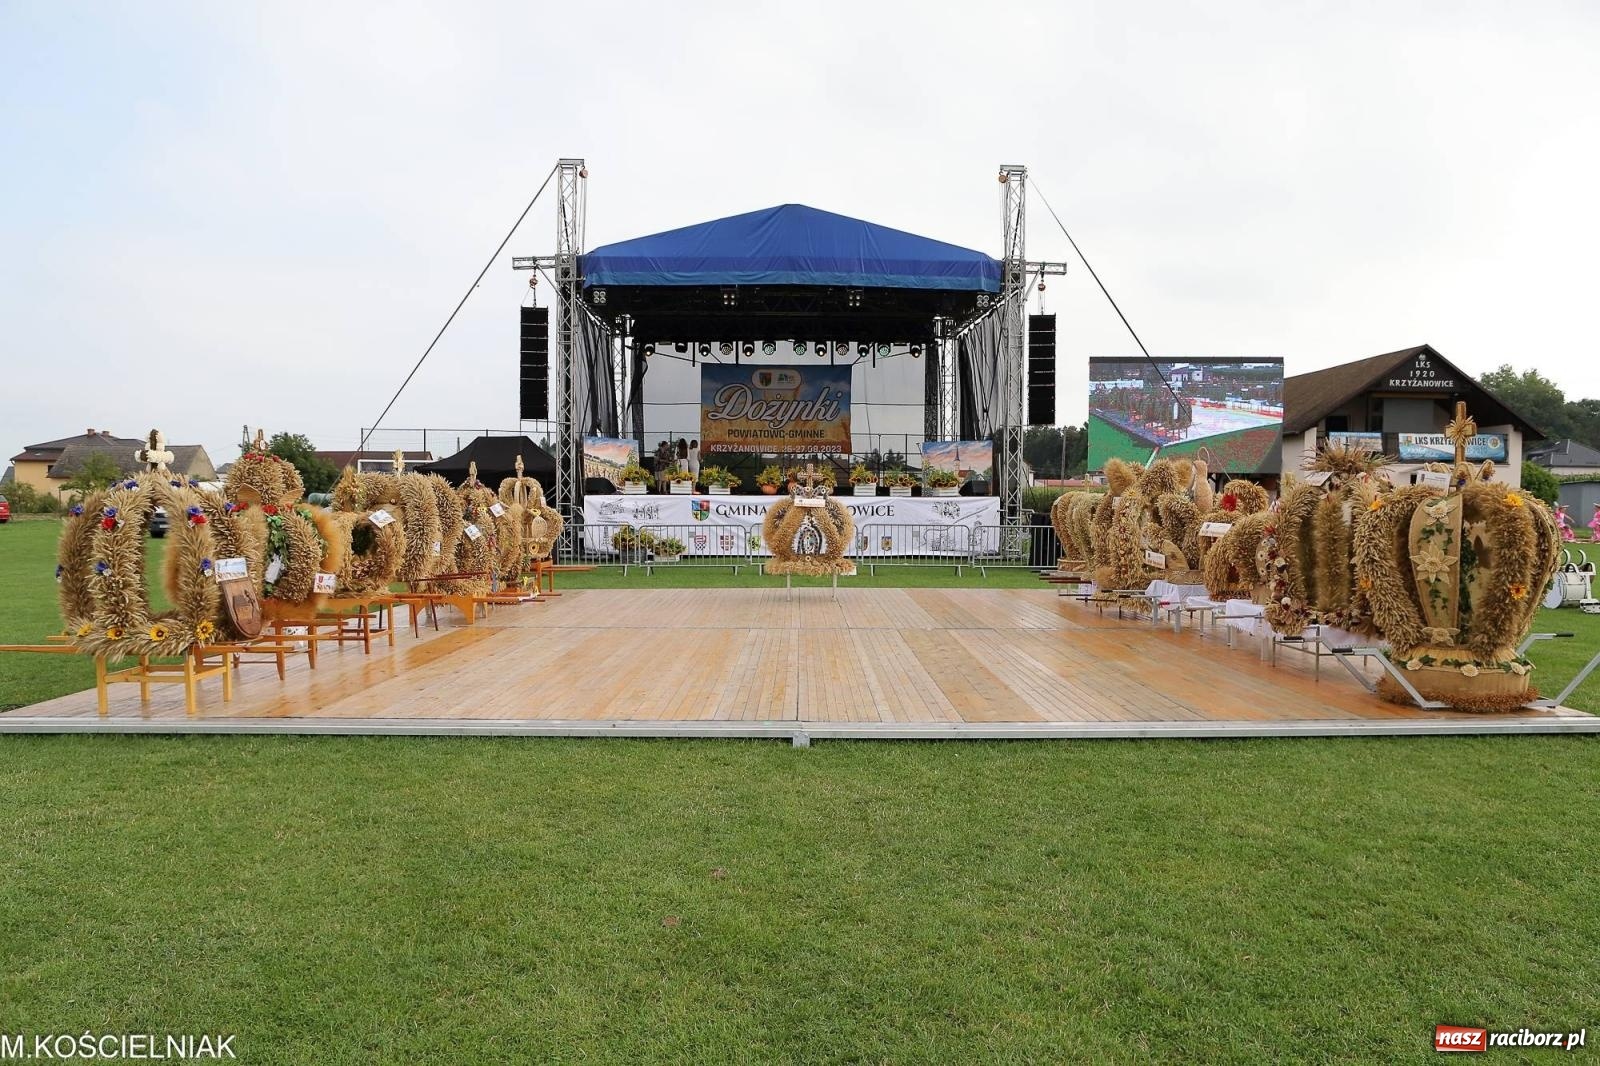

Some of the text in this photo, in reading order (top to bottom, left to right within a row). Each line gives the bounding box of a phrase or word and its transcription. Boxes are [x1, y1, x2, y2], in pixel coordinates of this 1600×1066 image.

[1410, 370, 1435, 378] 1920
[1389, 378, 1454, 387] KRZYŻANOWICE
[708, 383, 843, 429] Dożynki
[727, 429, 825, 439] POWIATOWO-GMINNE
[1415, 436, 1428, 445] LKS
[715, 504, 768, 518] GMINA
